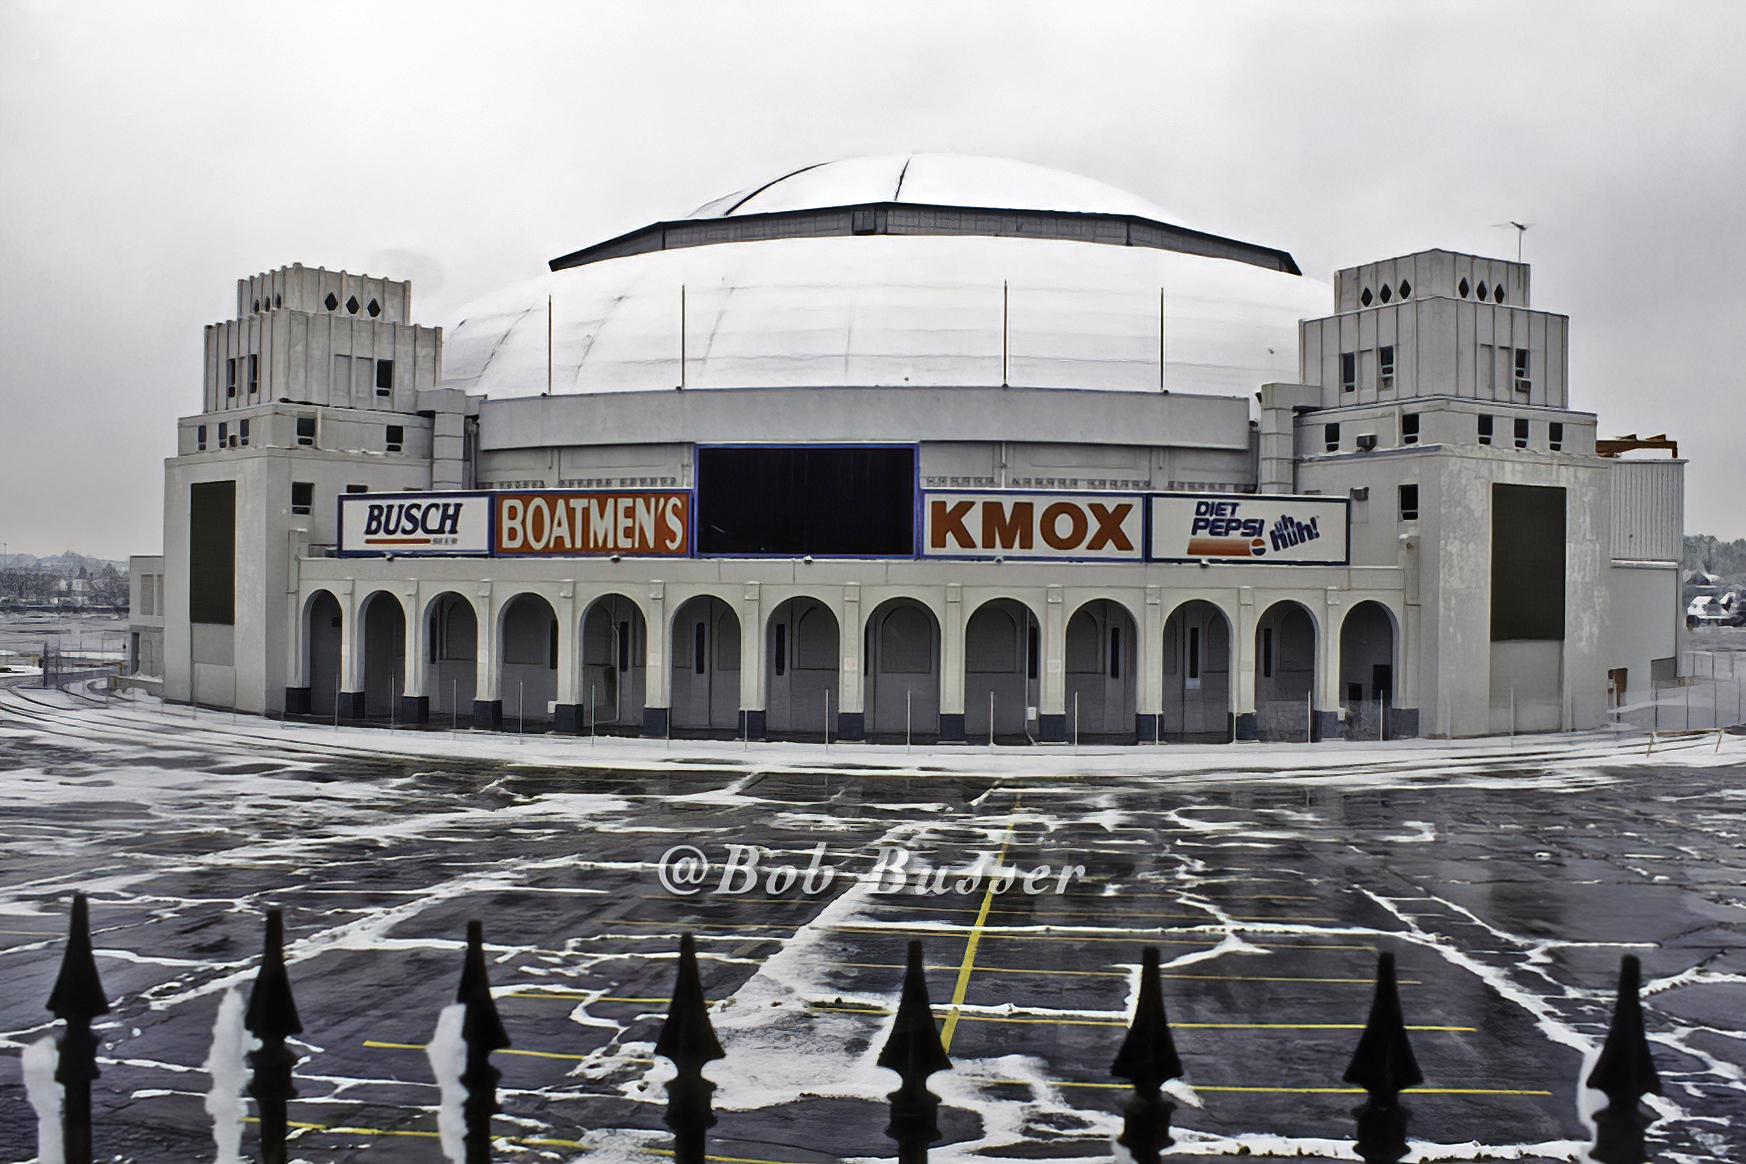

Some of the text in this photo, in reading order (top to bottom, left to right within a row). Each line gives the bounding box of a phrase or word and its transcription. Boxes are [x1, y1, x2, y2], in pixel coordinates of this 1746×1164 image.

[364, 503, 464, 535] BUSCH
[502, 497, 684, 550] BOATMEN'S
[1194, 501, 1240, 517] DIET
[931, 500, 1135, 551] KMOX
[1191, 518, 1265, 537] PEPSI
